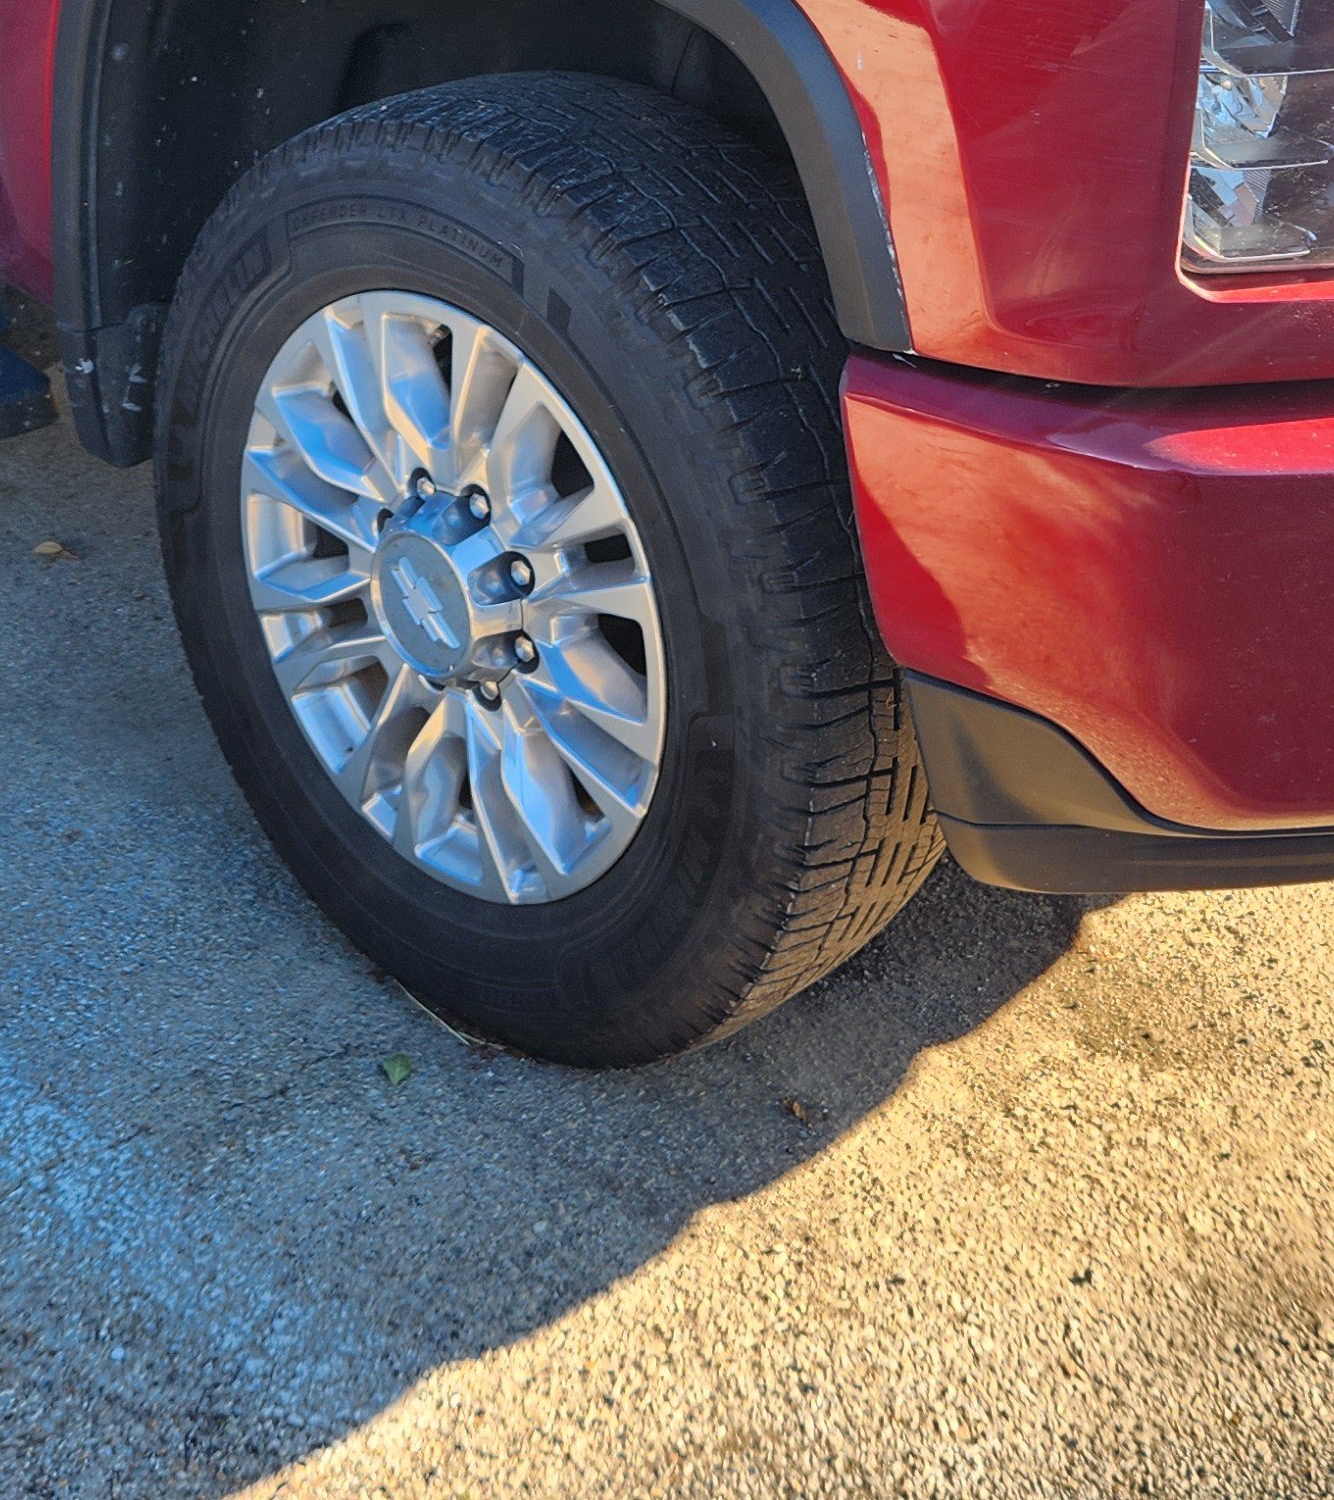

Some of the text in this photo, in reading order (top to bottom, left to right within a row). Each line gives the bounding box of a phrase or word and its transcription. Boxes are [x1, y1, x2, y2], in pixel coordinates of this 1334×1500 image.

[292, 205, 505, 269] DEFENDER LTX PLATINUM
[177, 240, 268, 412] MICHELIN
